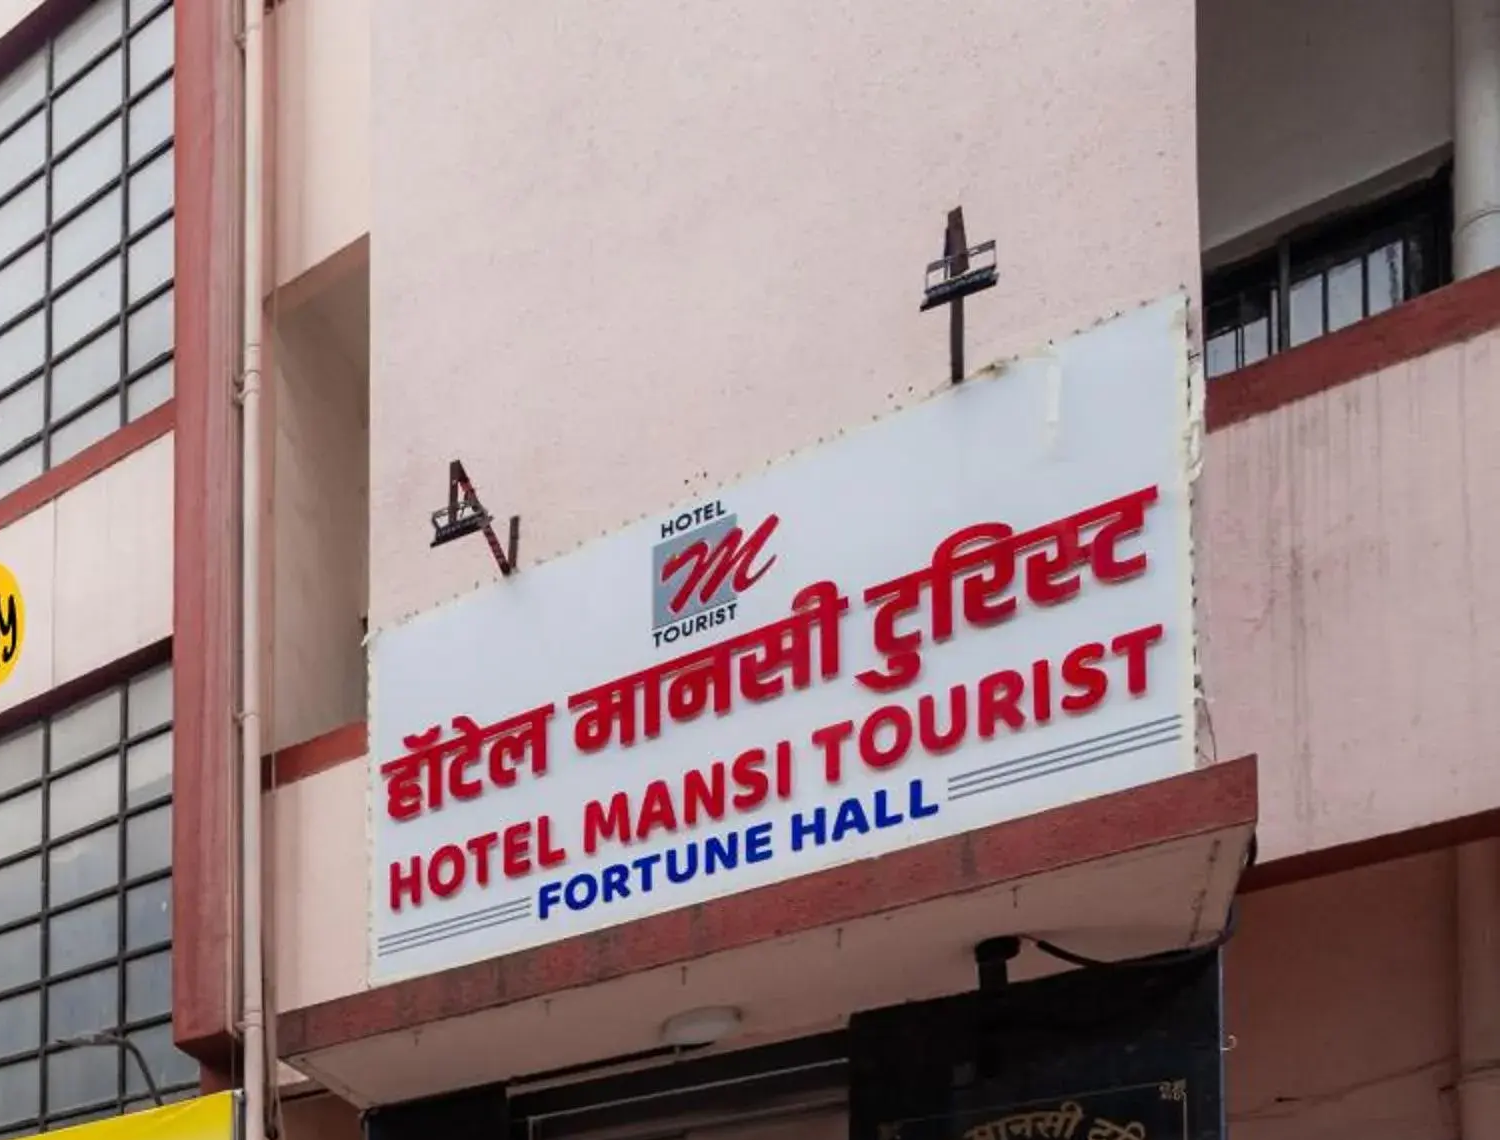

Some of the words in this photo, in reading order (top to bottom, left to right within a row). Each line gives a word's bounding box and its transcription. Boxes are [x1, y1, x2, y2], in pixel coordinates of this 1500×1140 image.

[660, 499, 727, 539] HOTEL
[380, 703, 554, 822] हॉटेल
[568, 580, 849, 754] मानसी
[855, 484, 1160, 692] टुरिस्ट
[653, 602, 738, 648] TOURIST
[389, 818, 566, 911] HOTEL
[583, 738, 791, 854] MANSI
[812, 624, 1163, 778] TOURIST
[537, 821, 773, 919] FORTUNE
[791, 778, 939, 851] HALL
